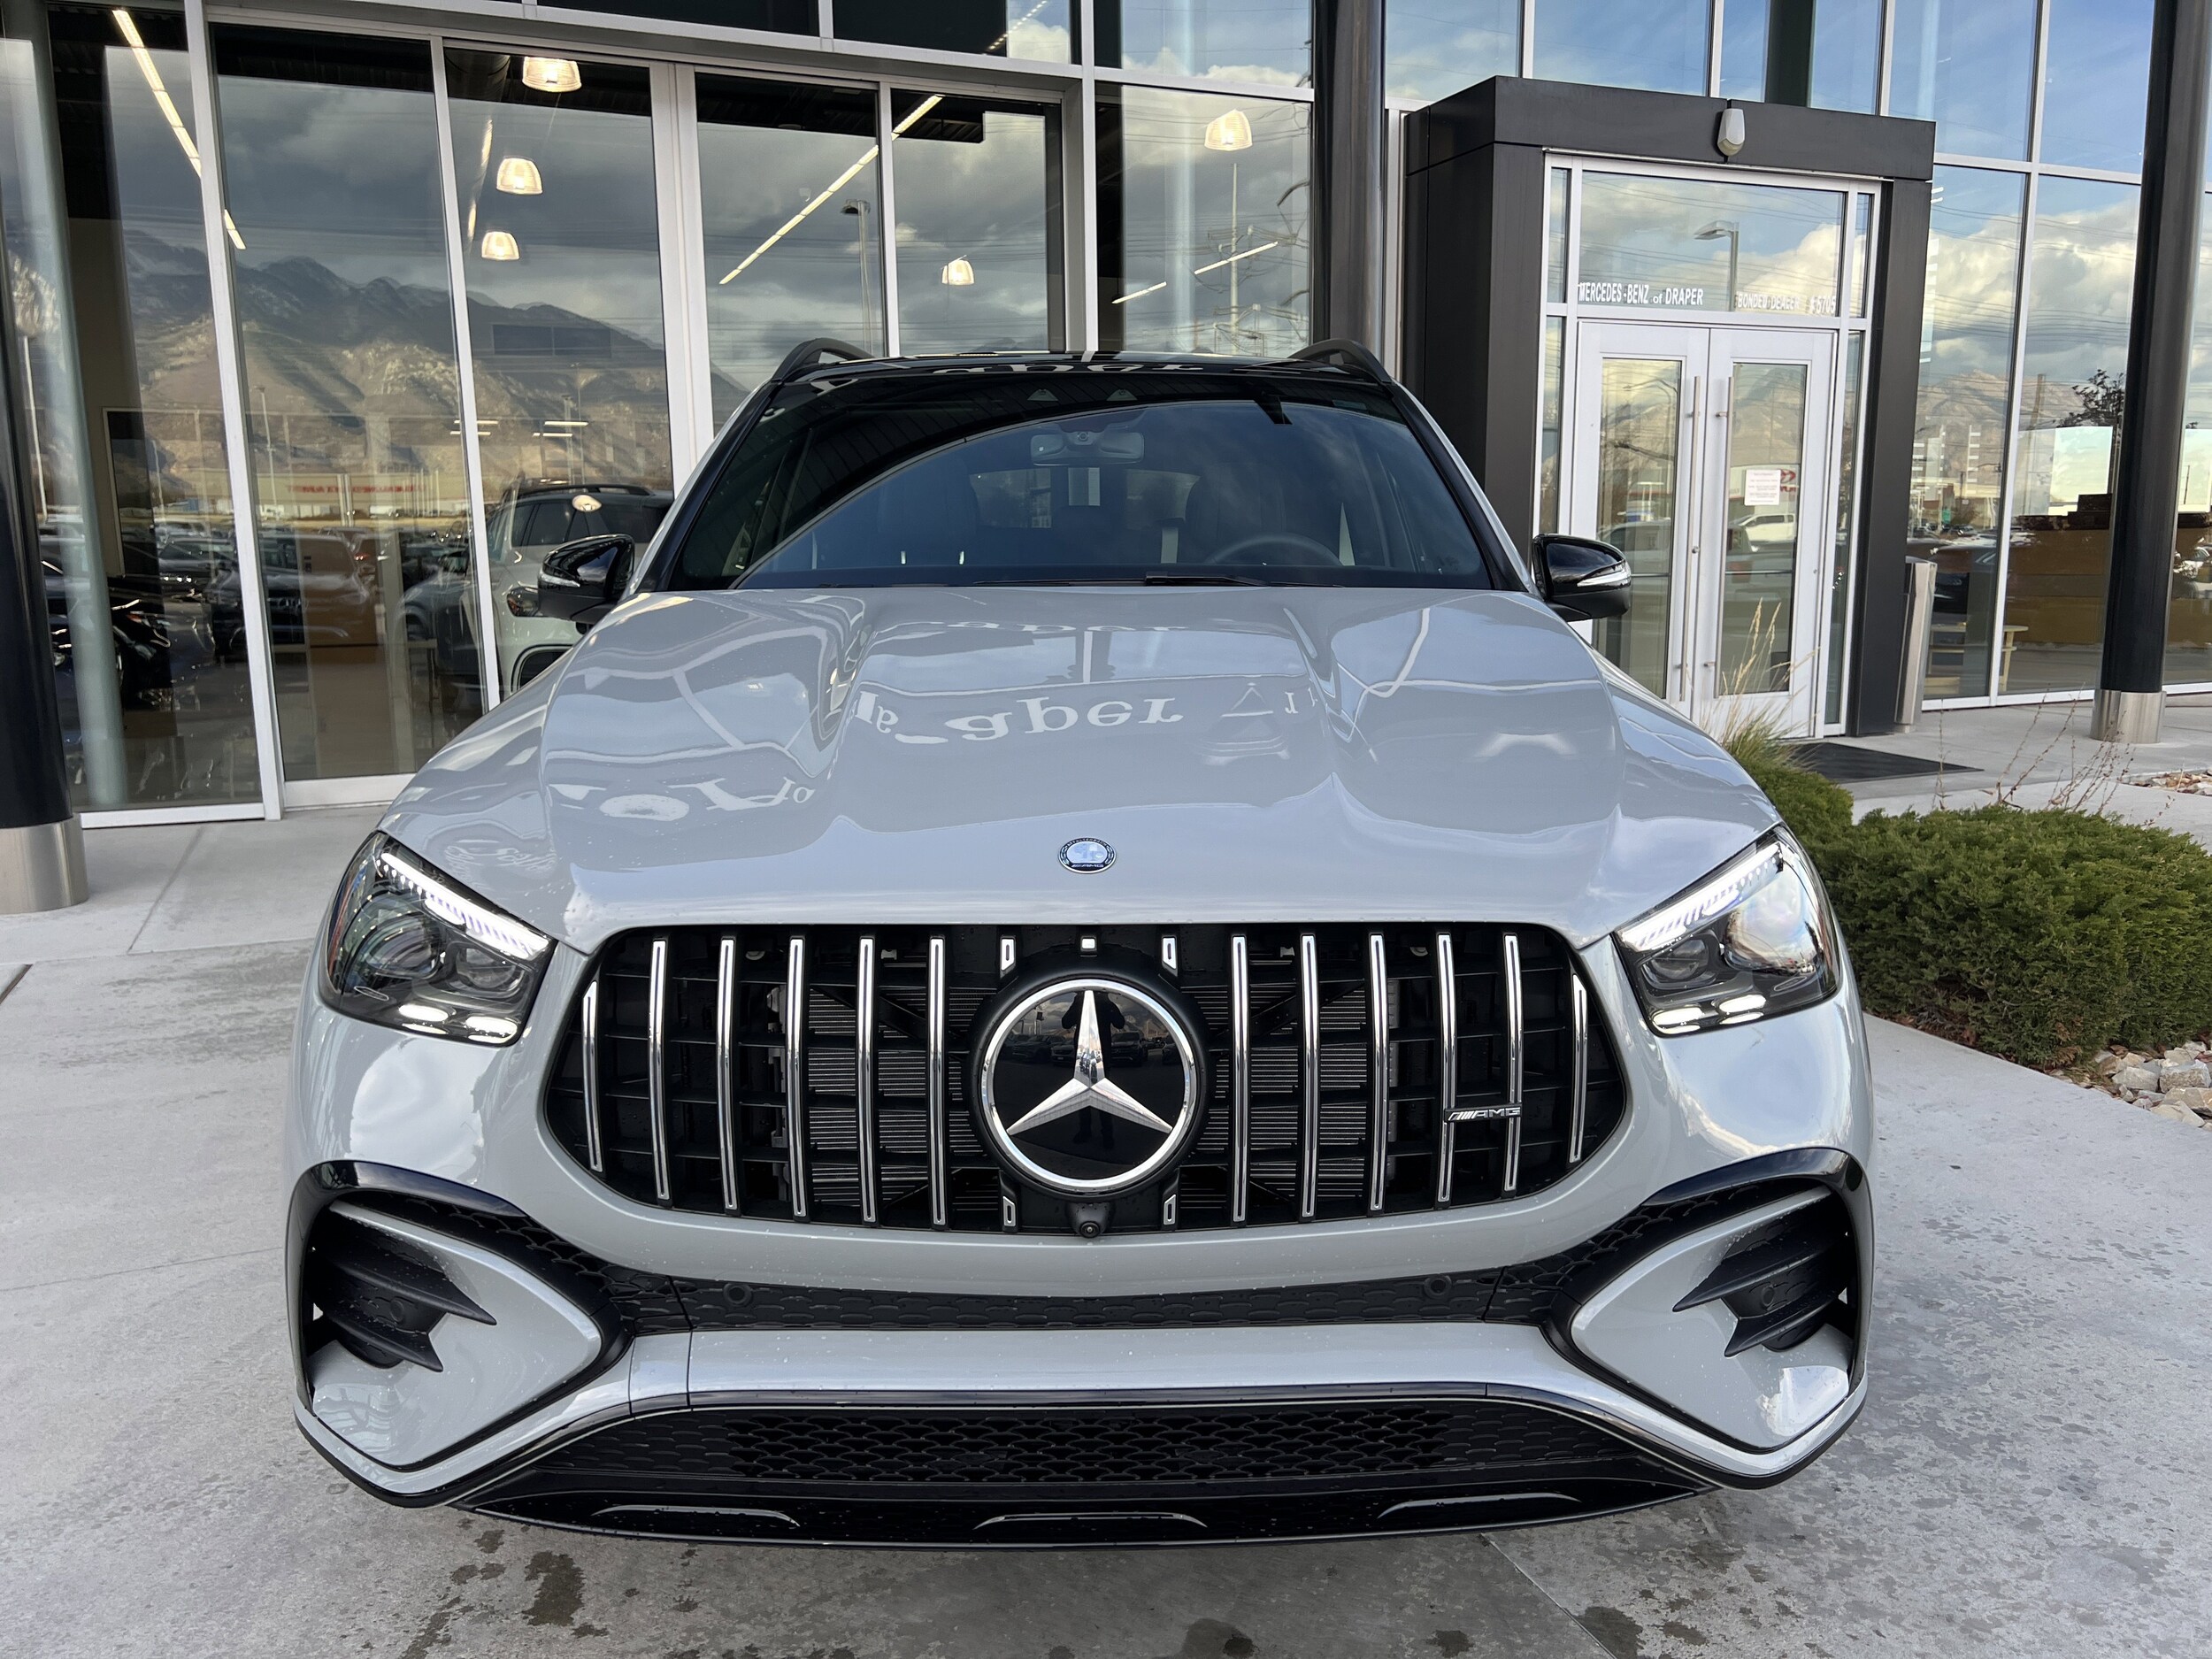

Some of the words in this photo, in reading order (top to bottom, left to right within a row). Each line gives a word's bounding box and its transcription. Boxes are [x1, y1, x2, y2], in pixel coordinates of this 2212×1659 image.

[1653, 293, 1663, 304] of
[1665, 288, 1704, 305] DRAPER
[1467, 1106, 1521, 1120] AMG
